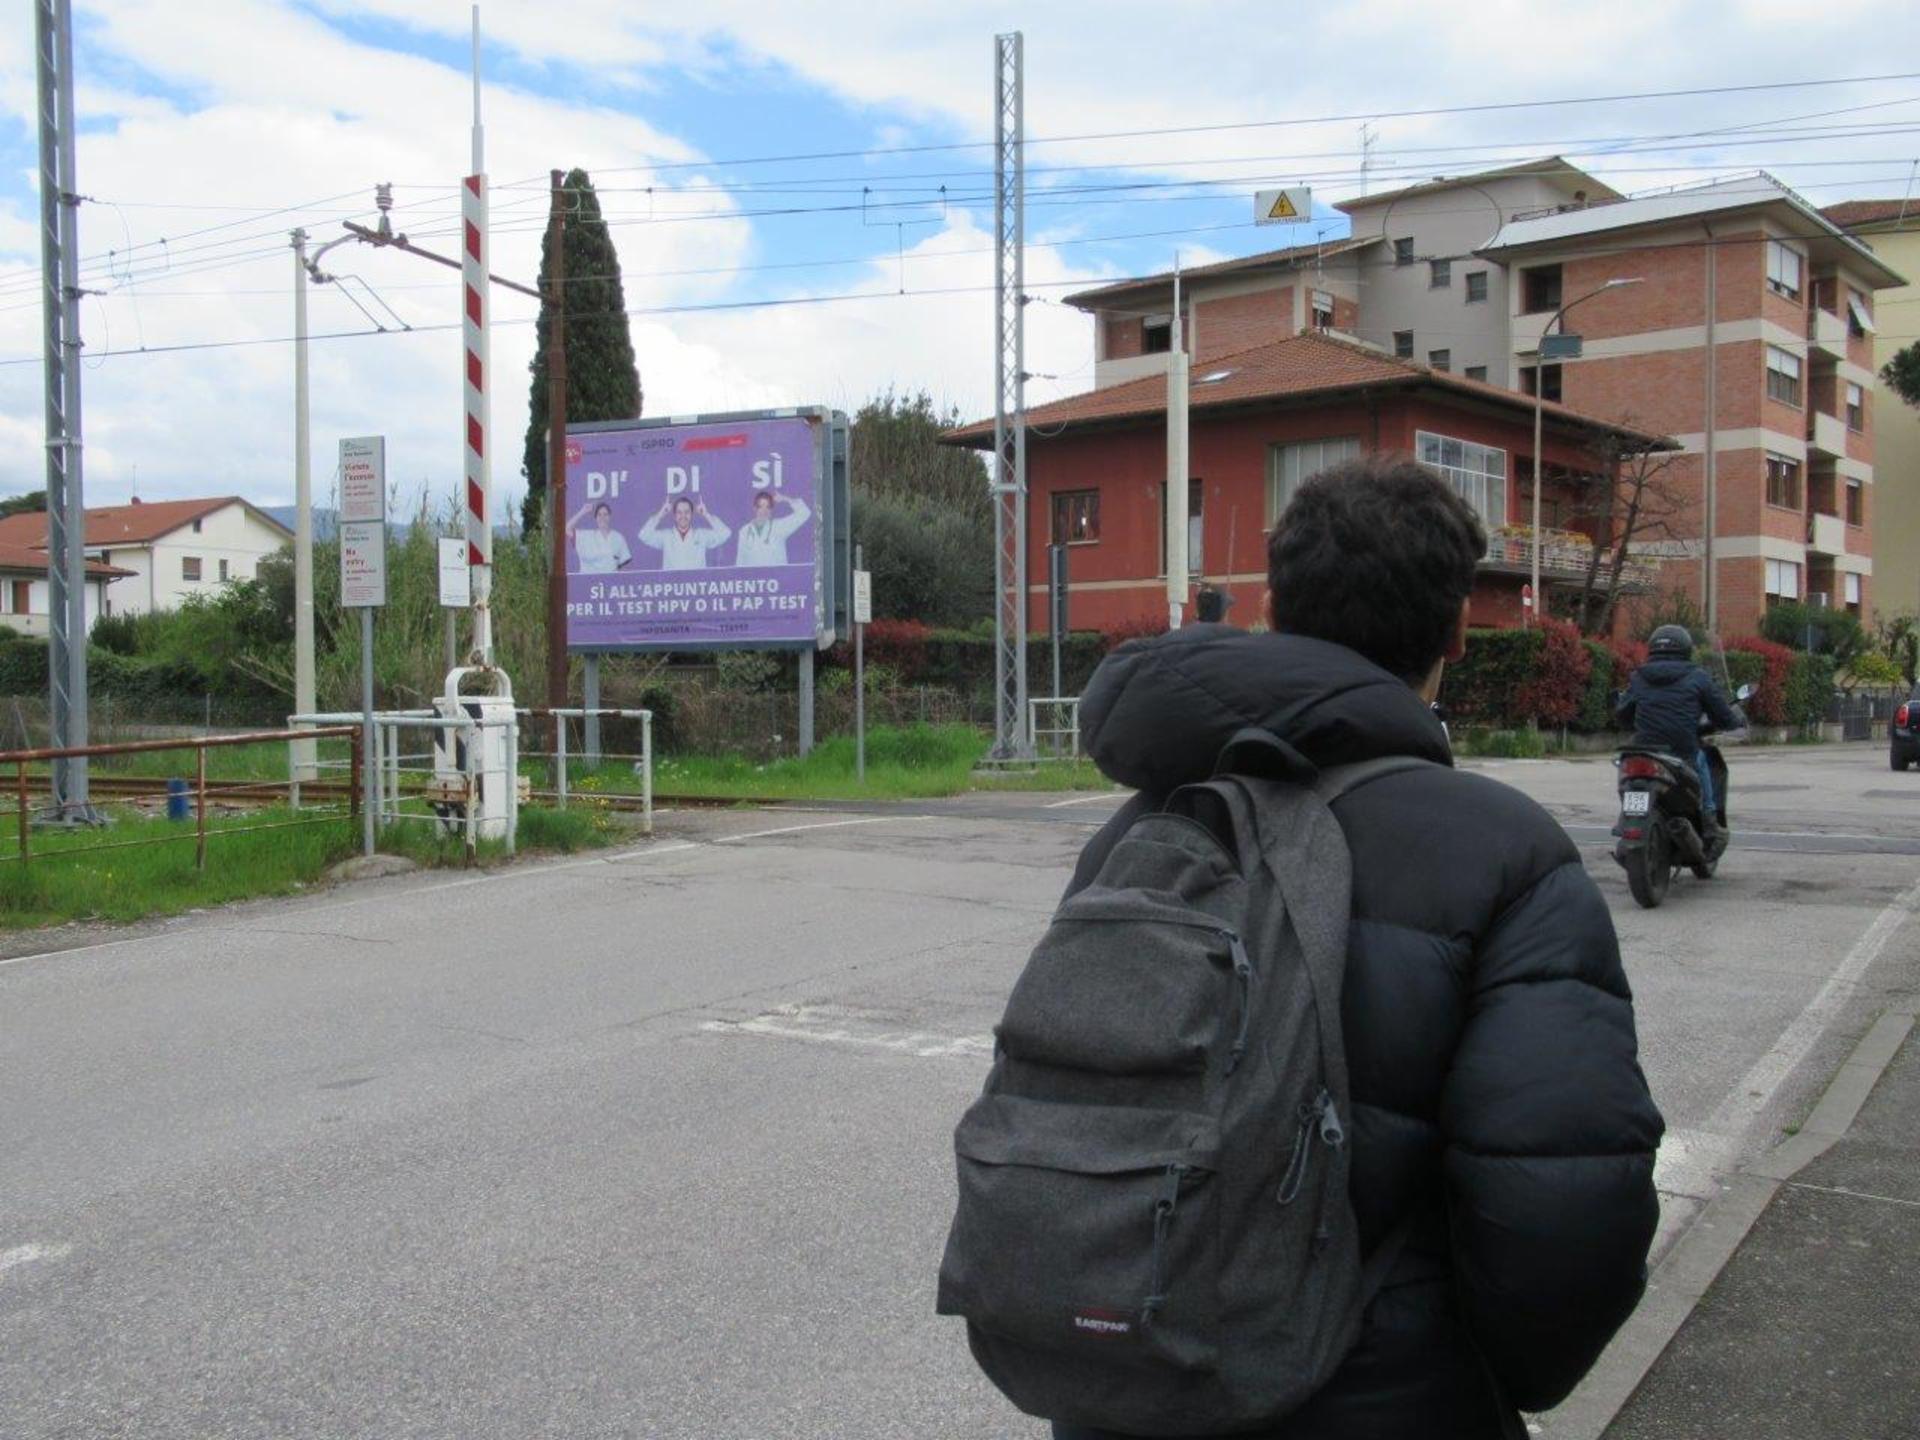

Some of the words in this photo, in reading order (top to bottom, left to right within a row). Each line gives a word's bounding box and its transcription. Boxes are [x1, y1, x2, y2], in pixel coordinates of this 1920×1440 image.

[666, 465, 700, 495] DI
[752, 452, 783, 489] SÌ
[590, 582, 605, 599] SÌ
[566, 602, 594, 616] PER
[599, 602, 613, 616] IL
[618, 600, 653, 615] TEST
[658, 600, 690, 613] HPV
[695, 598, 707, 612] O
[713, 597, 728, 611] IL
[732, 596, 763, 611] PAP
[768, 594, 808, 610] TEST
[1075, 1317, 1130, 1332] EASTPAK
